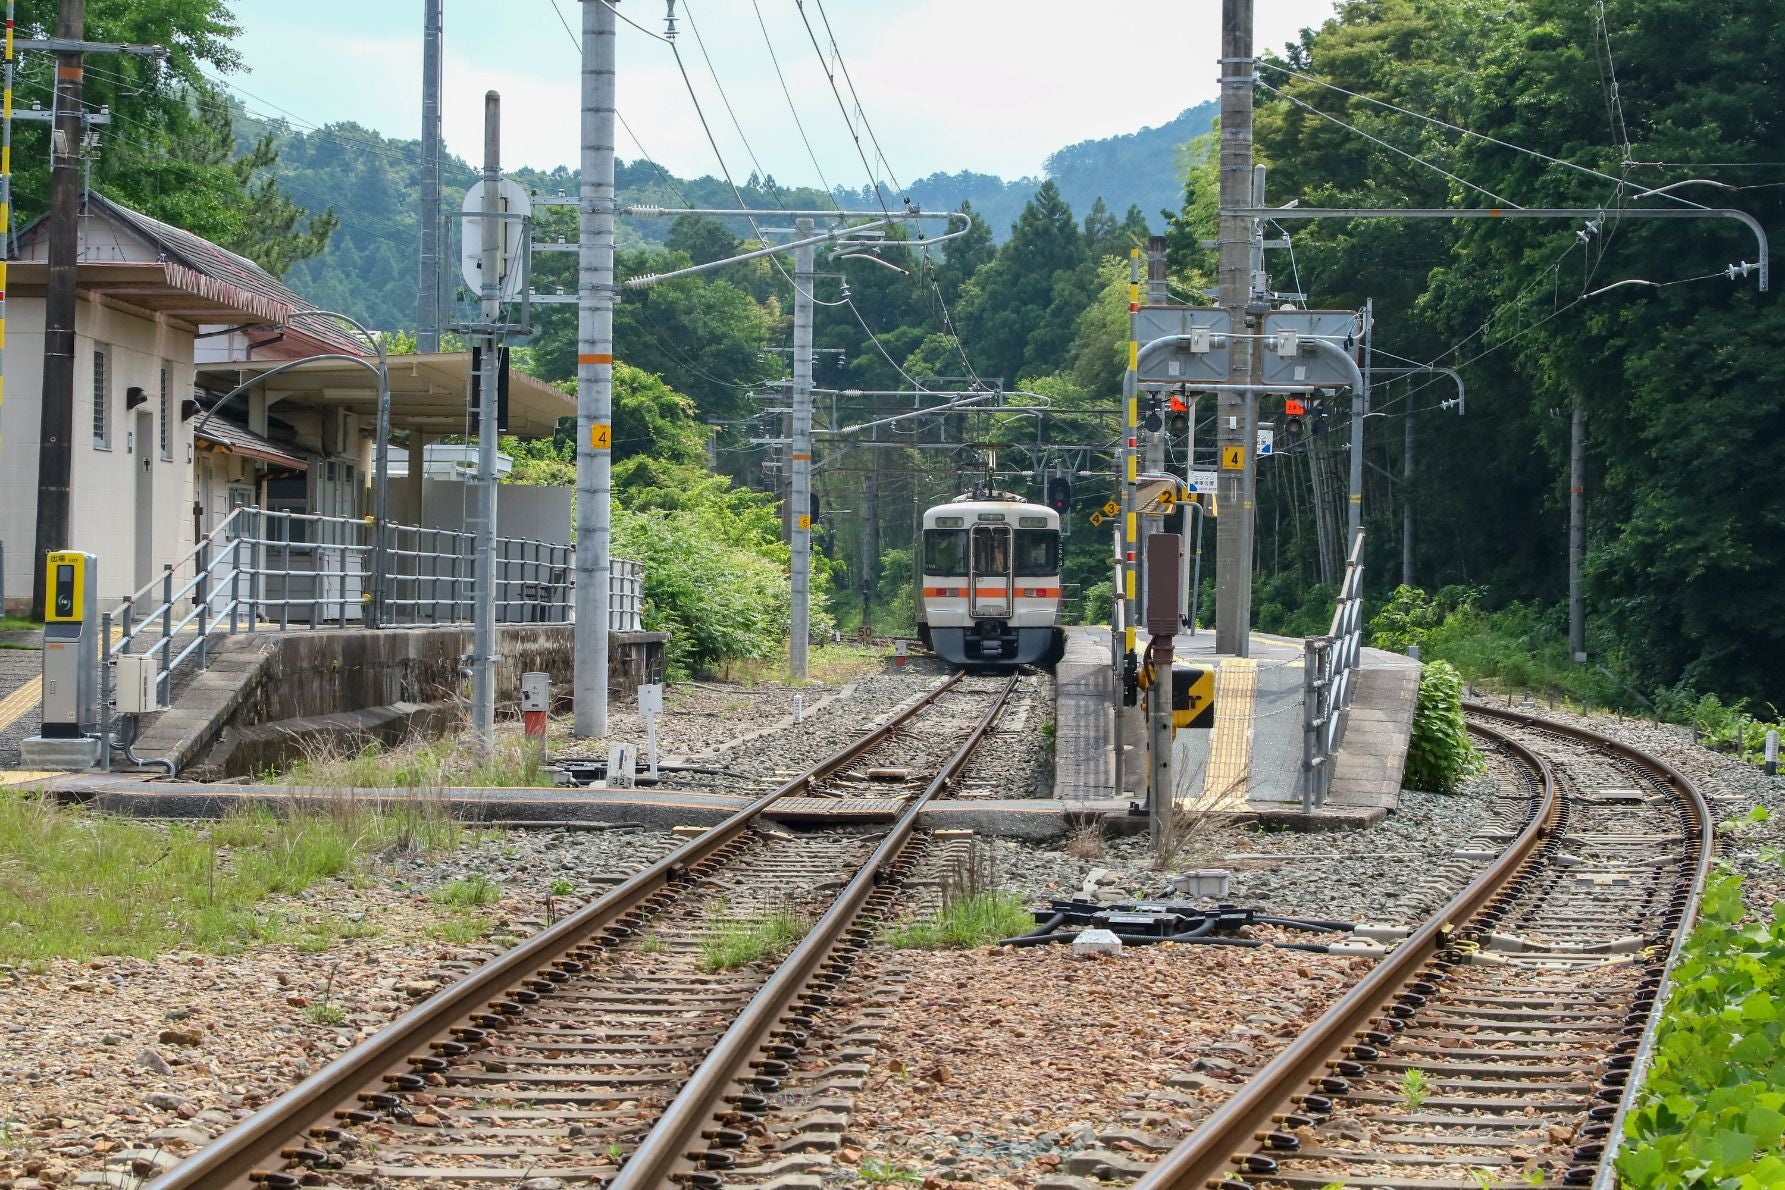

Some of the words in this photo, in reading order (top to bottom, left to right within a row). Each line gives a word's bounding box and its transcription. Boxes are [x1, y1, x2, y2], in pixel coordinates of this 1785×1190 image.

[598, 431, 607, 445] 4
[1231, 451, 1239, 465] 4
[1161, 490, 1173, 504] 2
[1107, 503, 1115, 515] 3
[1092, 513, 1101, 524] 4
[858, 627, 872, 637] 50
[612, 777, 625, 786] 32
